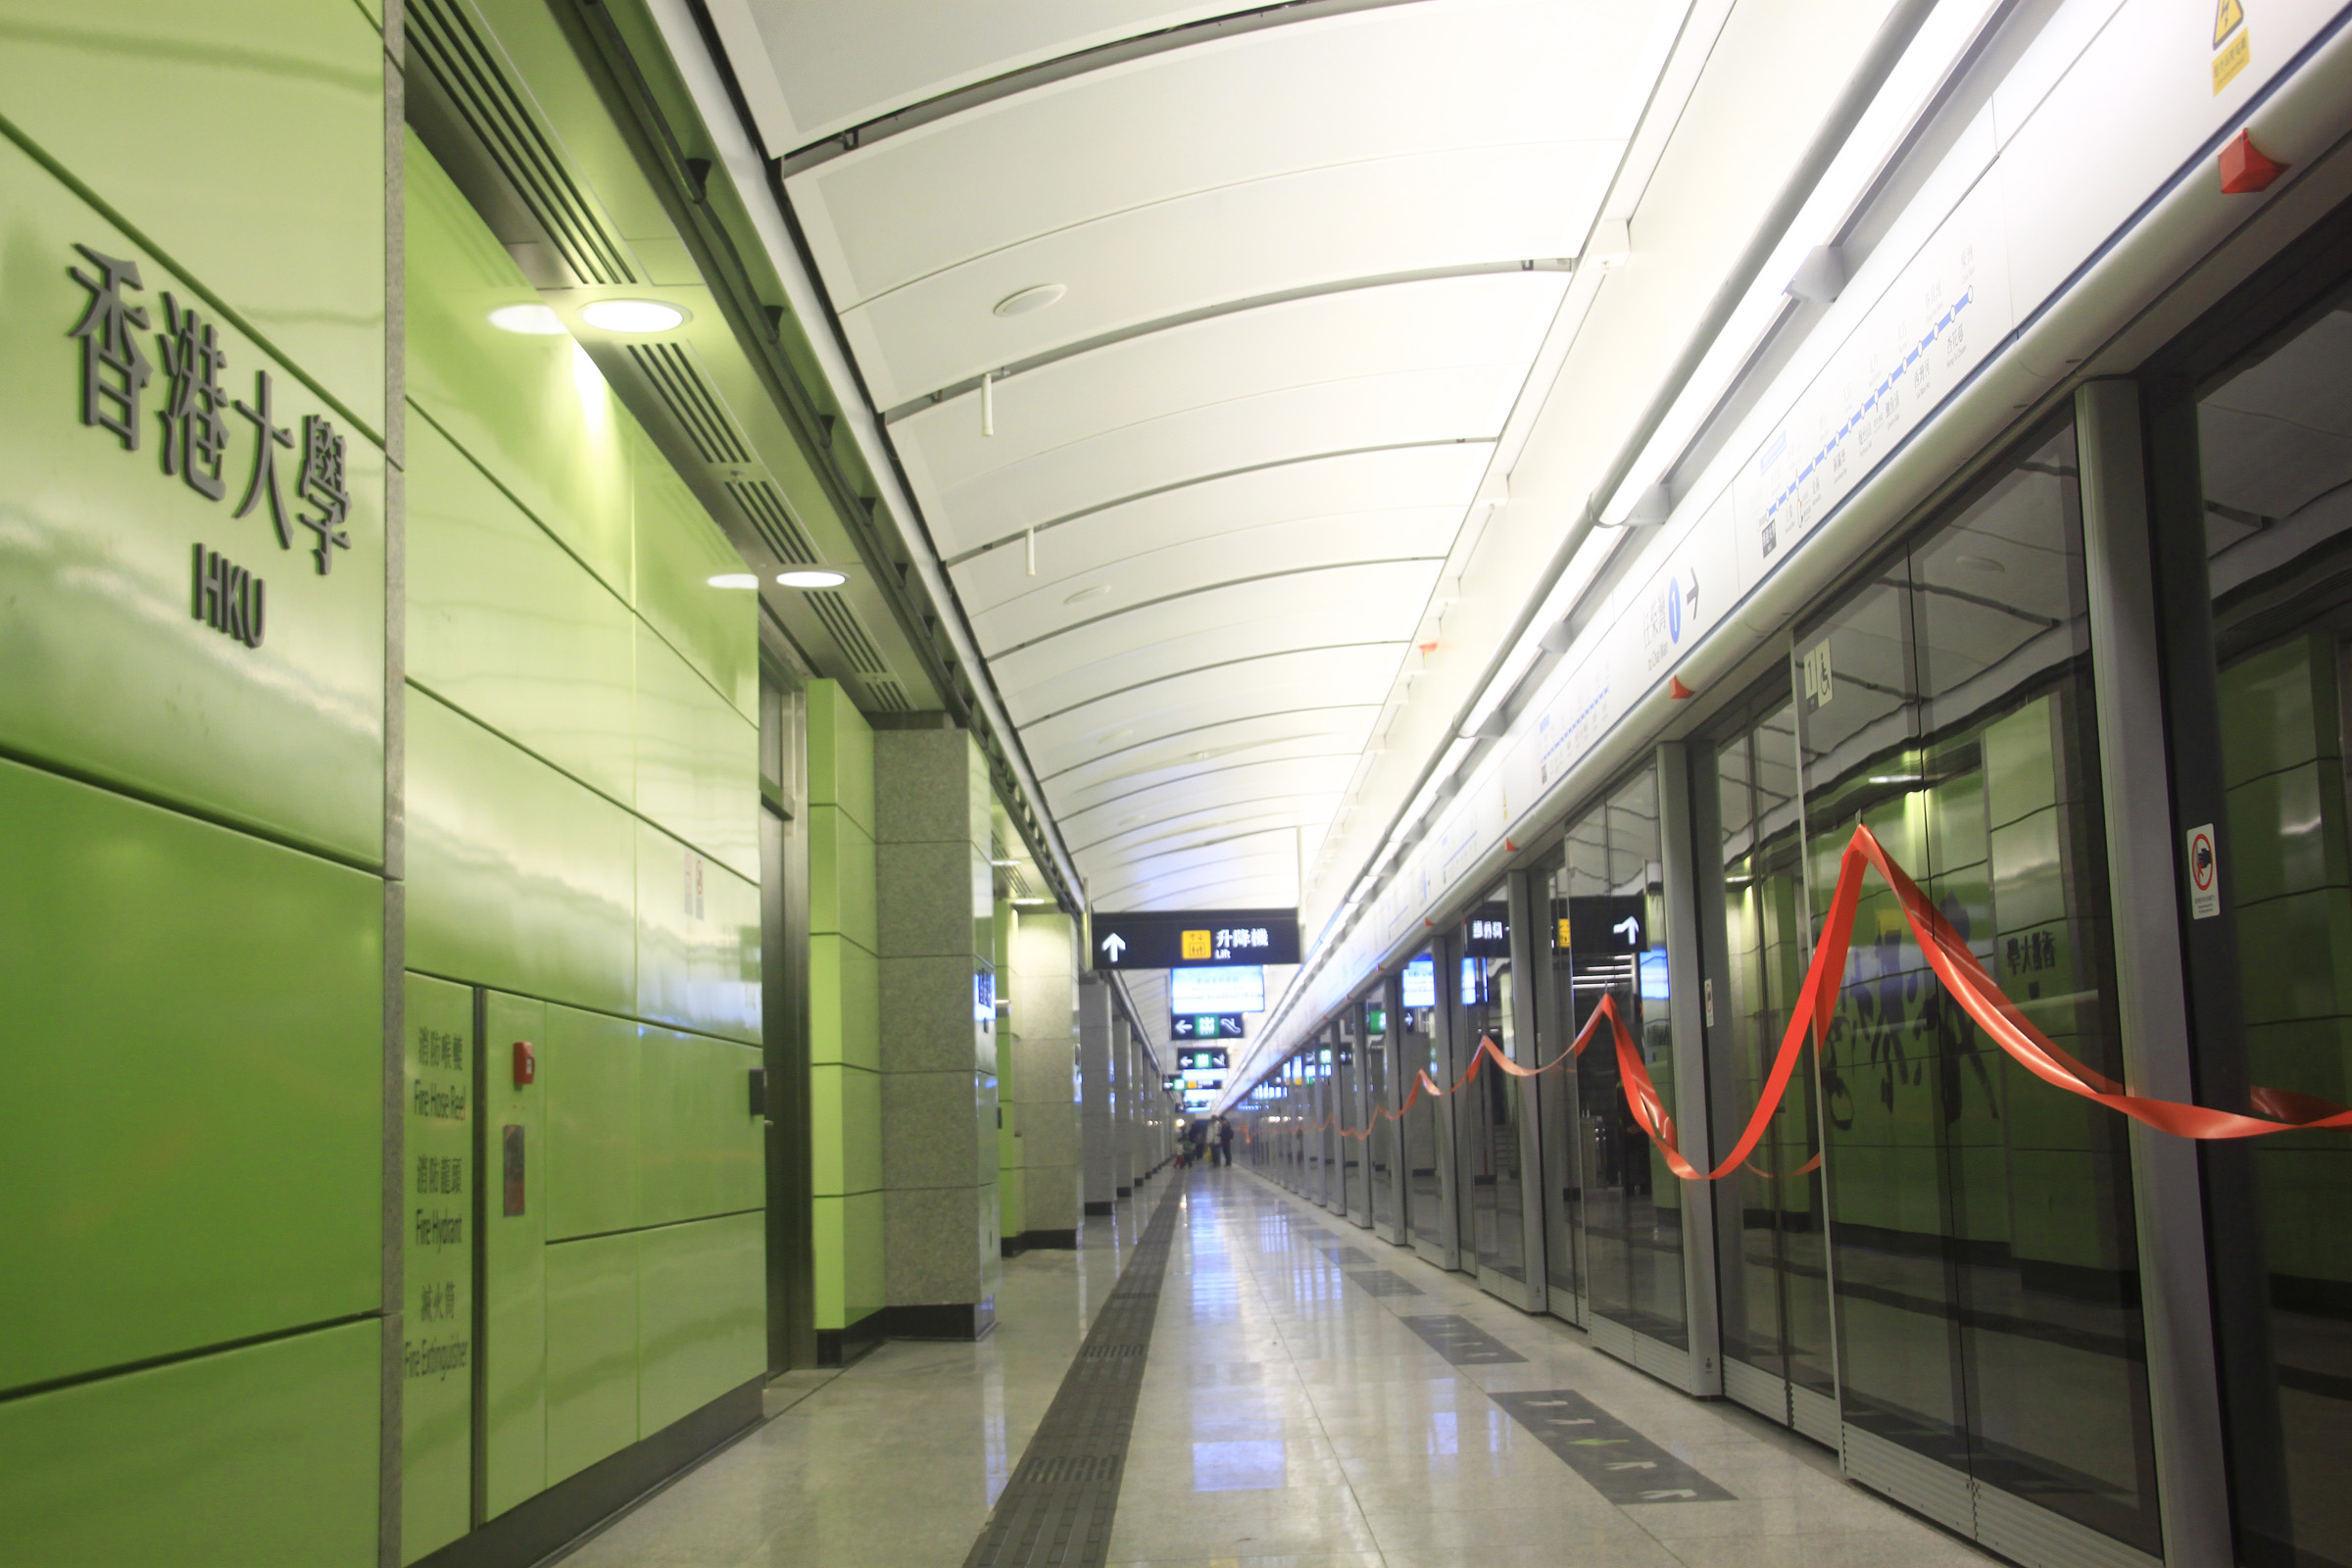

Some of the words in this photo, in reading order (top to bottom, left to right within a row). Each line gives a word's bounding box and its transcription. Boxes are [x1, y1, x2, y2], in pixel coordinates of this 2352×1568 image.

[67, 242, 353, 576] 香港大學
[191, 542, 267, 649] HKU
[1214, 948, 1232, 960] Lift
[1215, 927, 1269, 949] 升降機
[414, 1078, 429, 1117] Fire
[429, 1081, 449, 1119] Hose
[416, 1208, 431, 1246] Fire
[432, 1207, 463, 1254] Hydrant
[404, 1341, 420, 1380] Fire
